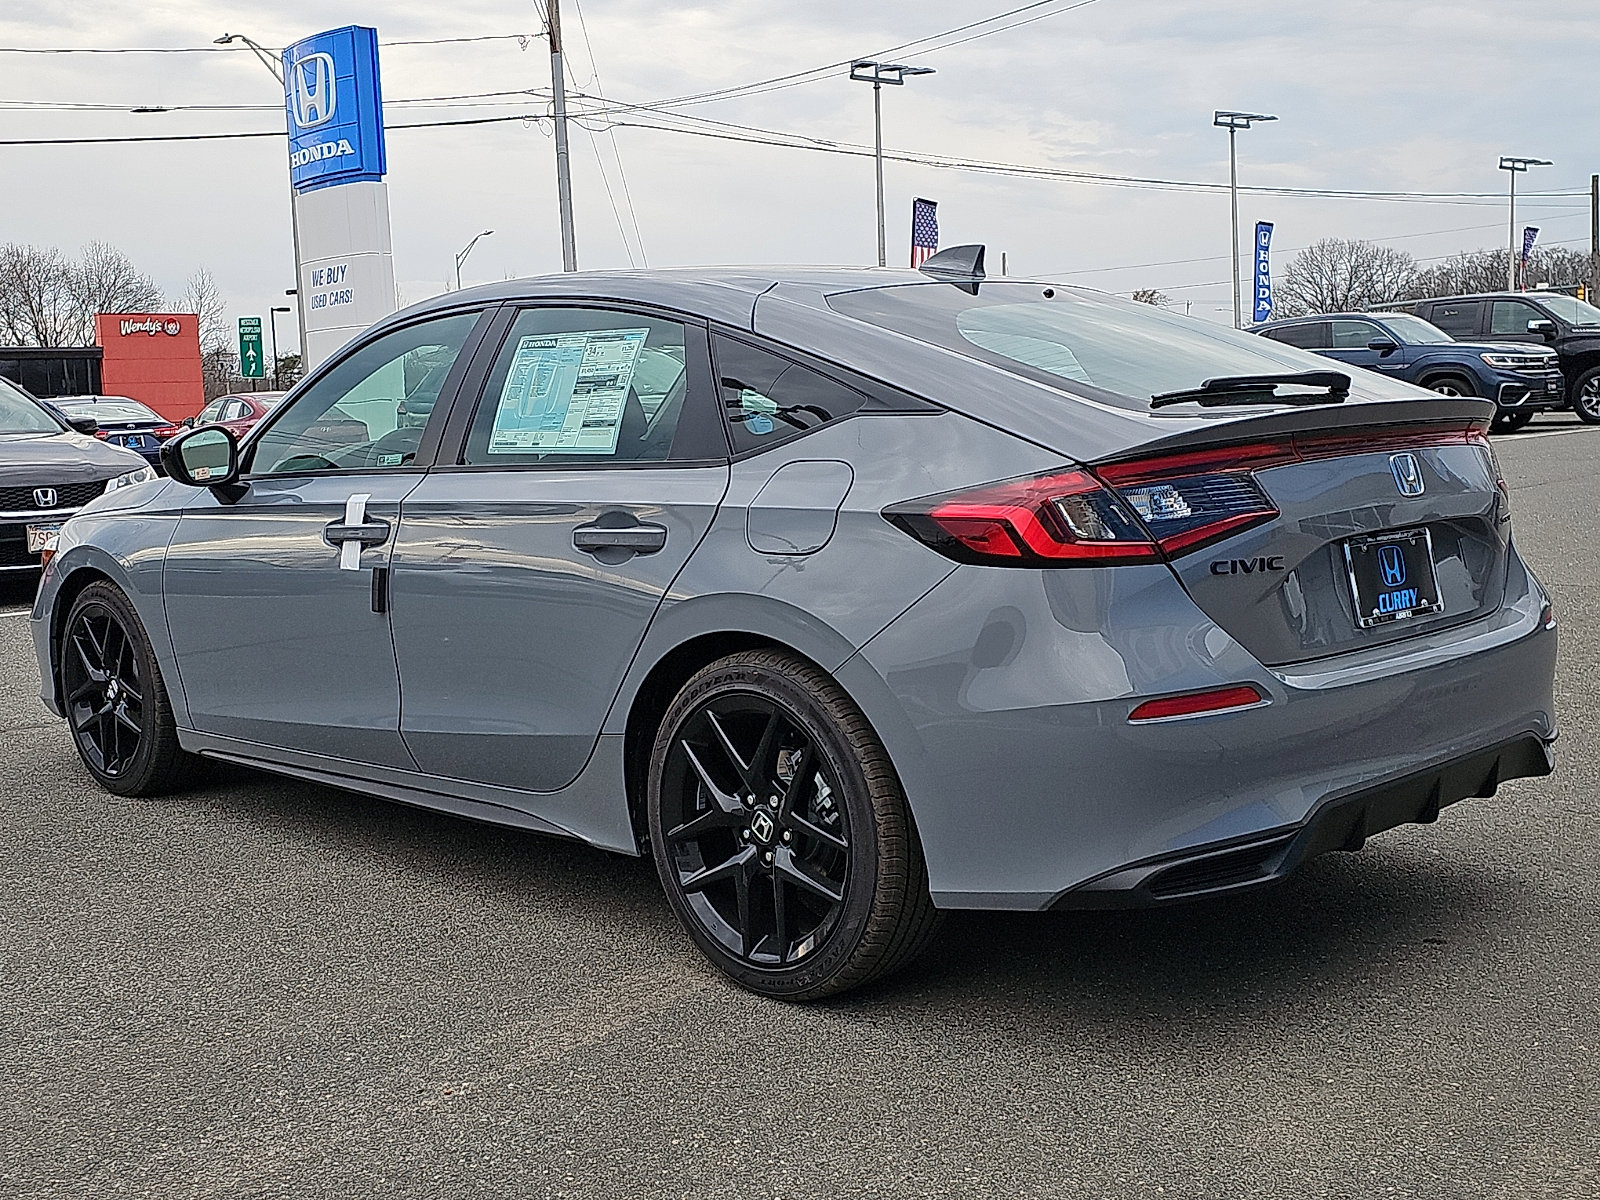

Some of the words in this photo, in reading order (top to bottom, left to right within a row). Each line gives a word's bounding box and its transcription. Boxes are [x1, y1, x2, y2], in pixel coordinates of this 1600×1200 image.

[290, 139, 355, 167] HONDA
[312, 269, 324, 287] WE
[326, 265, 347, 285] BUY
[1257, 250, 1271, 311] HONDA
[311, 293, 327, 310] USED
[330, 289, 353, 307] CARS!
[120, 316, 162, 336] Wendy's
[528, 340, 557, 348] HONDA
[1210, 556, 1285, 576] CIVIC
[1378, 587, 1418, 613] CURRY
